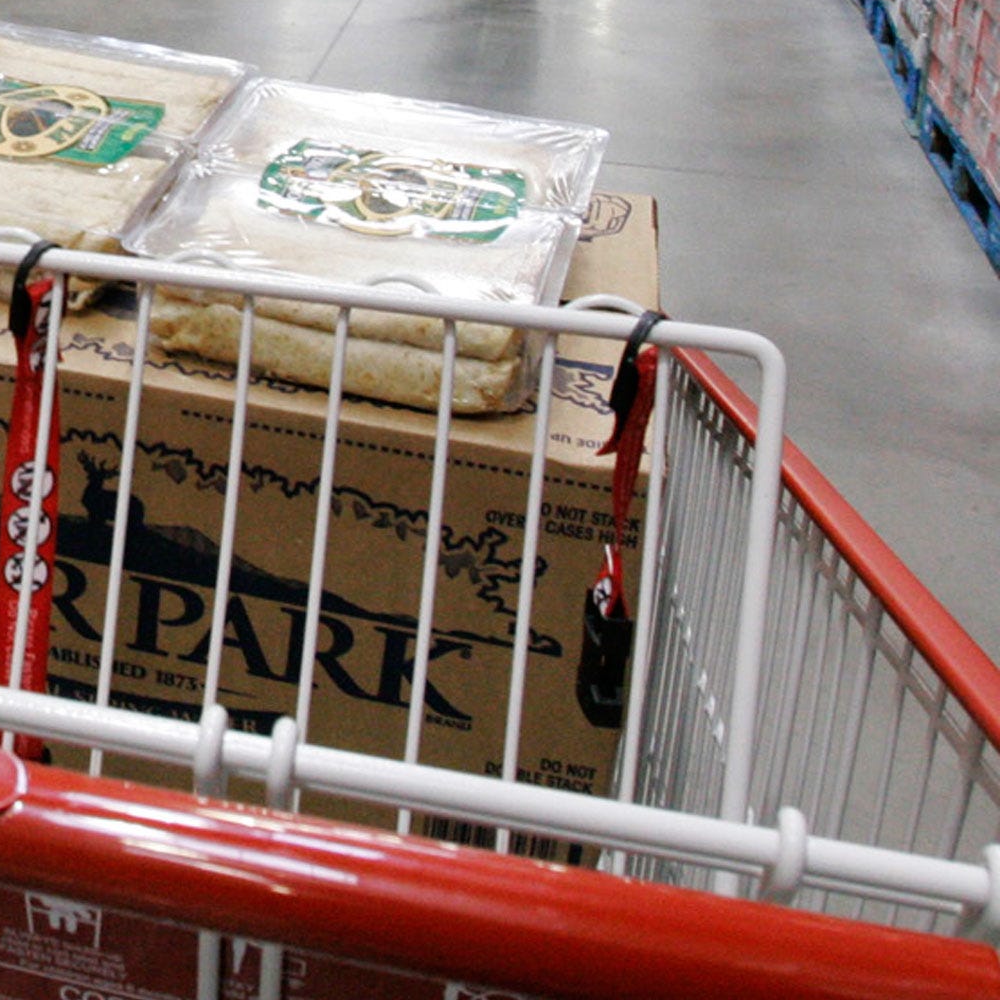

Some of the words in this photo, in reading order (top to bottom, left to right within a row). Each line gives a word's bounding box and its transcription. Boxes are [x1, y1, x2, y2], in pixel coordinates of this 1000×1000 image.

[576, 436, 605, 450] IDE
[485, 509, 527, 527] OVER
[544, 520, 594, 541] CASES
[556, 505, 588, 522] NOT
[592, 511, 641, 533] STAK
[130, 576, 473, 723] PARK
[49, 645, 148, 679] ABLISED
[155, 668, 198, 693] 1873
[485, 760, 545, 784] DOBLE
[540, 757, 562, 773] DO
[566, 762, 597, 781] NOT
